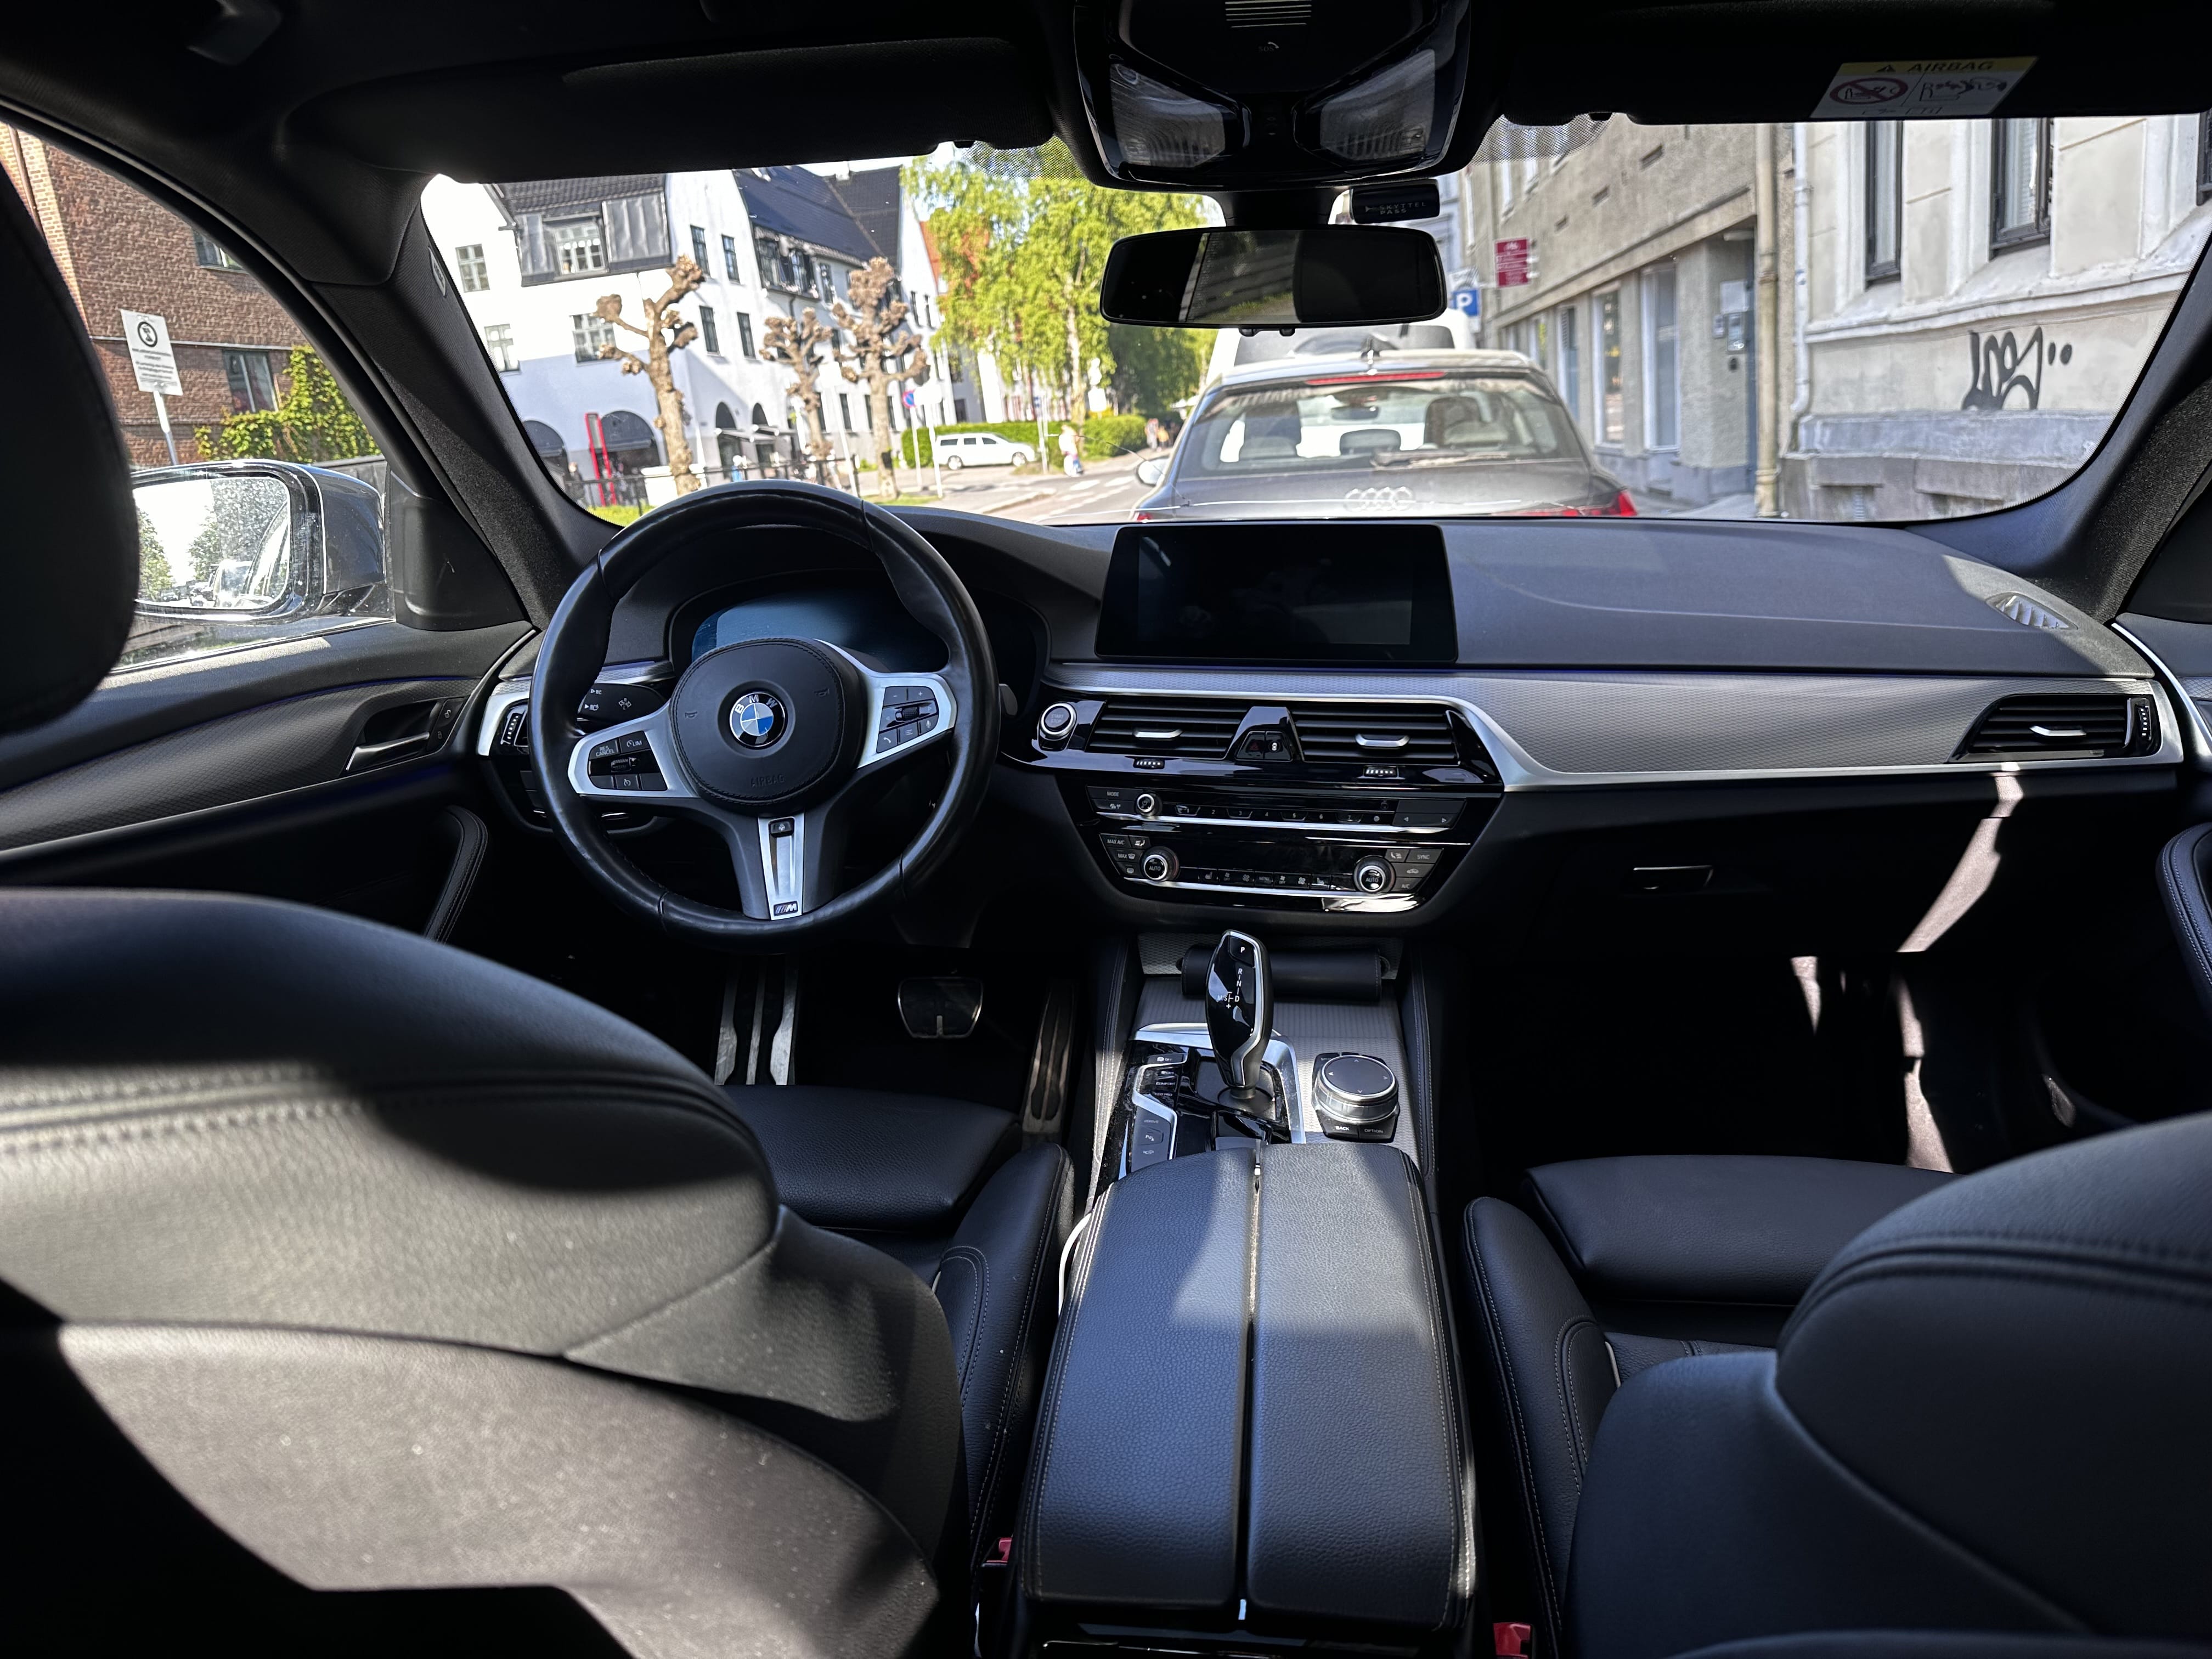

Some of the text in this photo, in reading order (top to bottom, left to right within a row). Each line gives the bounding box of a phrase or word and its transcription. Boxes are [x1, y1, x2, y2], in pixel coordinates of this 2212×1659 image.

[1908, 61, 1995, 72] AIRBAG
[1457, 293, 1472, 312] P
[734, 693, 778, 714] BMW
[751, 774, 786, 787] AIRBAG
